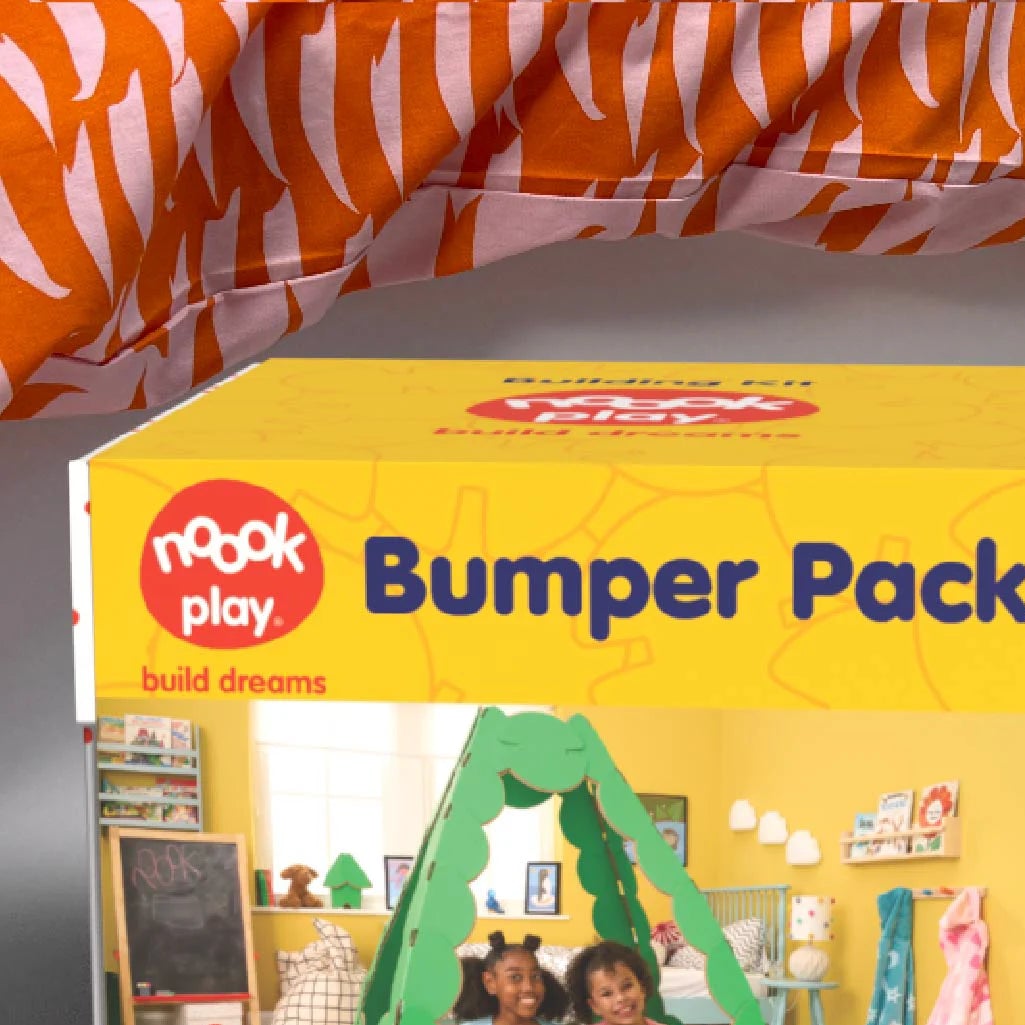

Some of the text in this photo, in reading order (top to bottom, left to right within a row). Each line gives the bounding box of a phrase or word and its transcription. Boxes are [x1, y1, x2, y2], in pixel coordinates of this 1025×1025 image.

[533, 410, 718, 425] play
[364, 535, 759, 641] Bumper
[182, 585, 275, 638] play
[141, 665, 327, 694] build dreams
